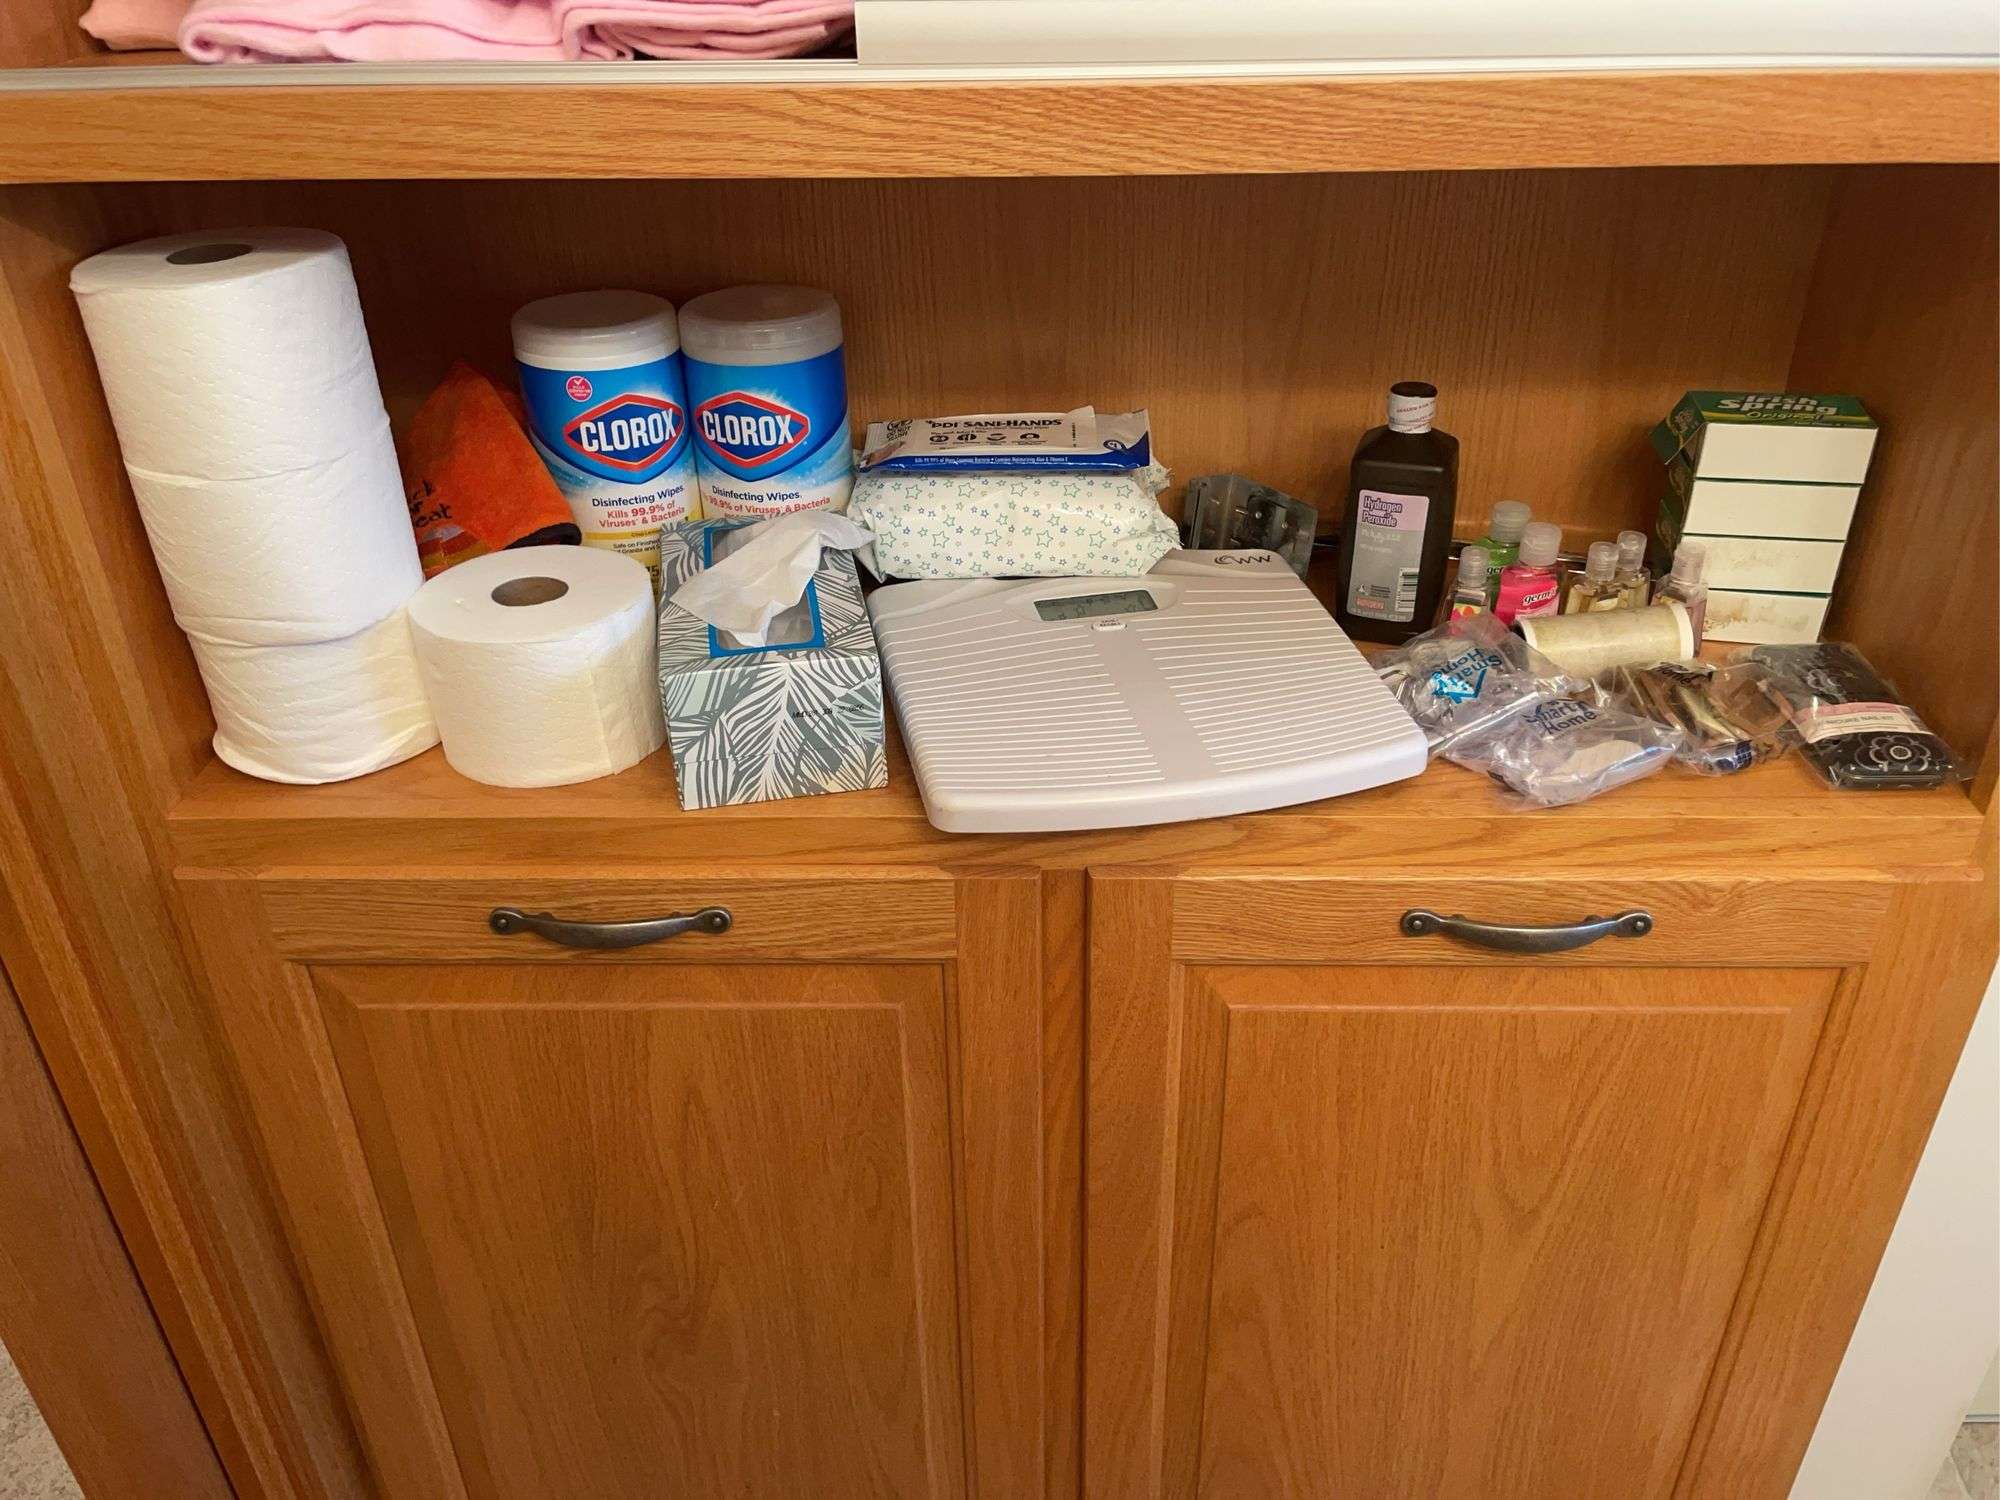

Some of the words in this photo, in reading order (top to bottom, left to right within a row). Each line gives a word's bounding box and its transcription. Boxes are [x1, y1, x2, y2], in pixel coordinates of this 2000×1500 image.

[1717, 399, 1838, 415] Spring
[580, 407, 676, 452] CLOROX
[702, 410, 794, 446] CLOROX
[963, 418, 1063, 428] SANI-HANDS
[592, 494, 655, 507] Disinfecting
[657, 485, 684, 500] Wipes
[712, 485, 763, 503] Disinfecting
[766, 490, 800, 502] Wipes
[607, 510, 629, 519] Kills
[631, 504, 665, 517] 99.9%
[667, 500, 676, 510] of
[794, 496, 831, 512] Bacteria
[1363, 496, 1402, 514] Hydrogen
[641, 516, 649, 524] &
[651, 506, 685, 522] Bacteria
[1362, 510, 1397, 527] Peroxide
[1540, 710, 1597, 735] Home
